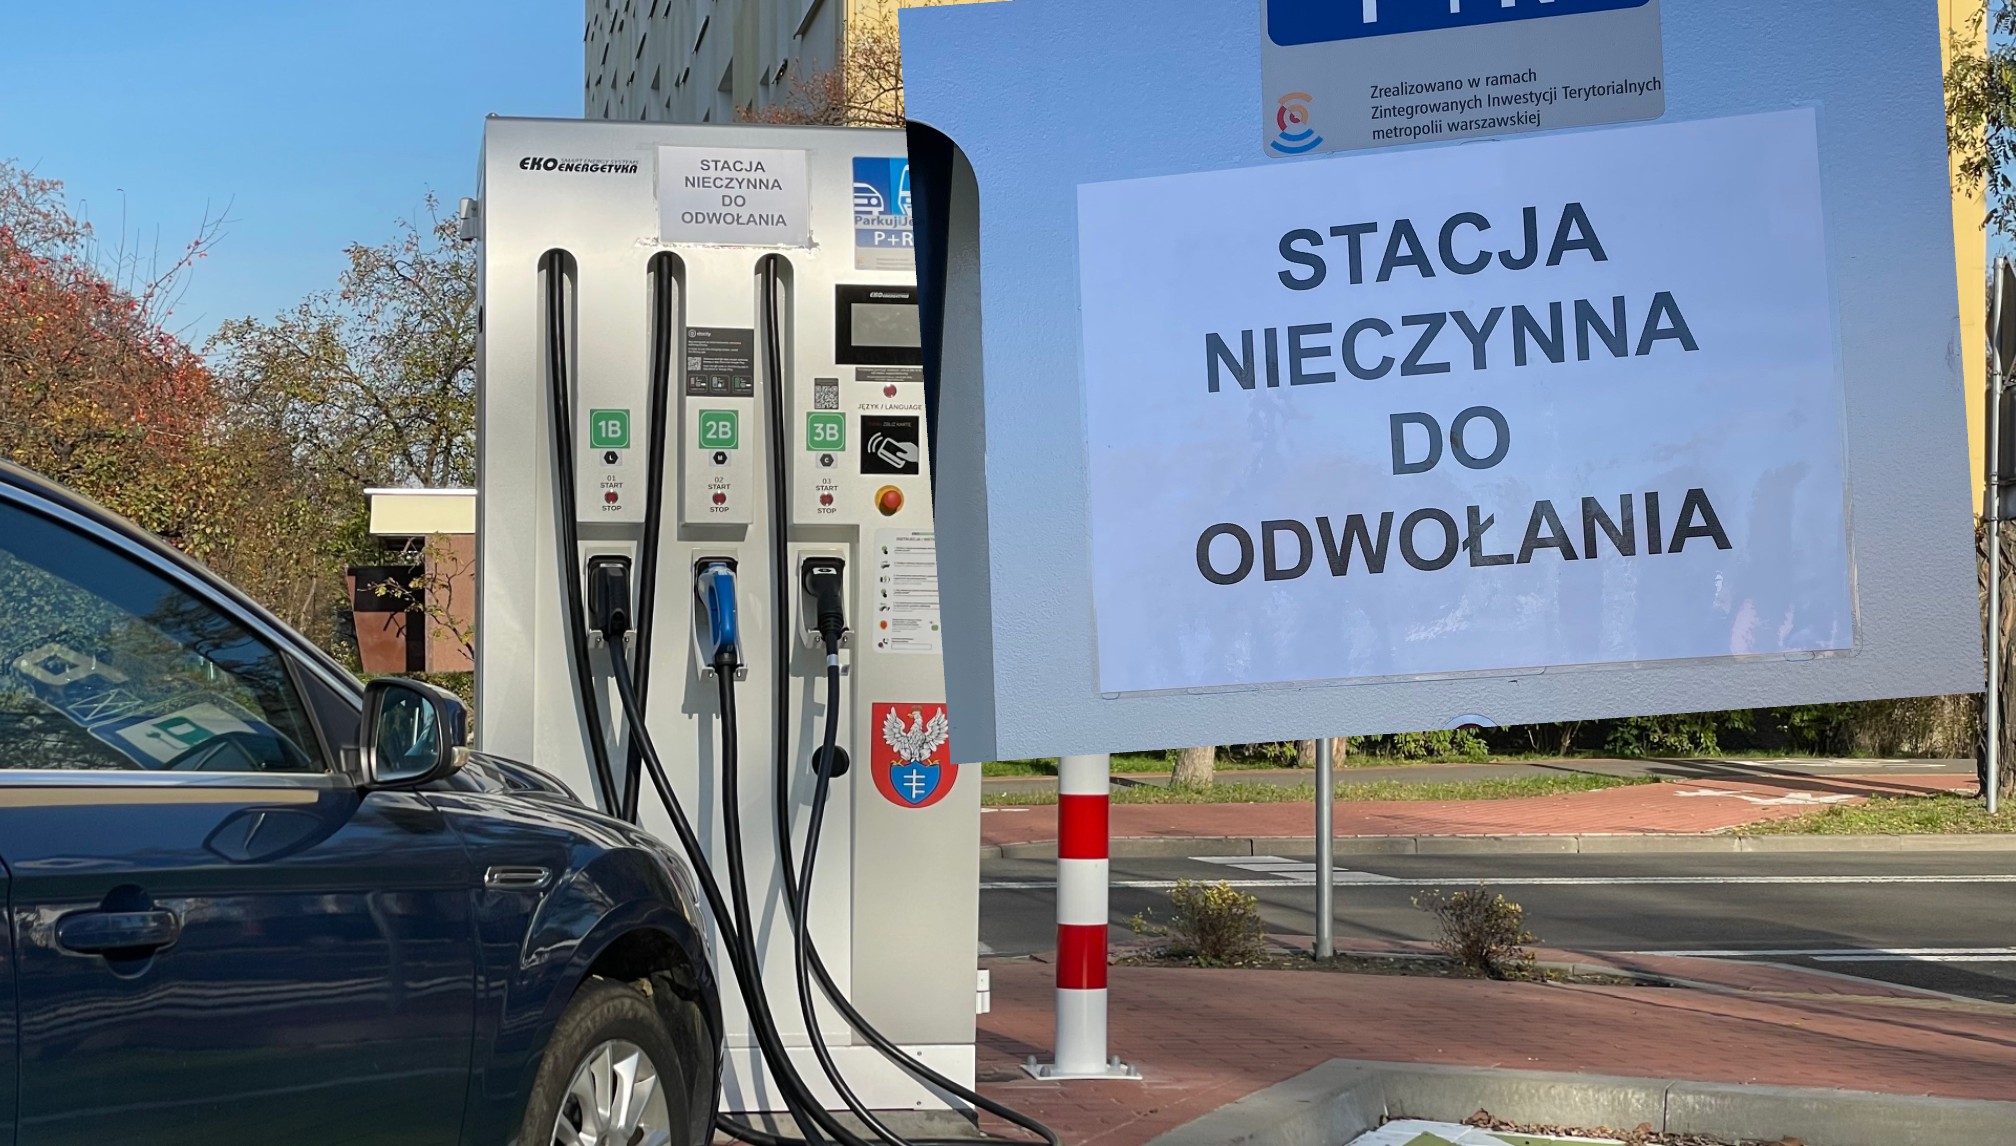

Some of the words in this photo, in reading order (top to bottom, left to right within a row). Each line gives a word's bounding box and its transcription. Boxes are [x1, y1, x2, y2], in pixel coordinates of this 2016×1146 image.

[1370, 79, 1463, 98] Zrealizowano
[1468, 77, 1480, 88] w
[1486, 68, 1537, 86] ramach
[1371, 95, 1482, 119] Zintegrowanych
[1487, 87, 1557, 106] Inwestycji
[1562, 76, 1662, 101] Terytorialnych
[1372, 120, 1442, 140] metropolii
[1447, 110, 1541, 132] warszawskiej
[519, 157, 558, 172] EKO
[558, 163, 638, 174] ENERGETYKA
[700, 159, 766, 172] STACJA
[684, 176, 782, 190] NIECZYNNA
[722, 194, 746, 207] DO
[681, 211, 788, 226] ODWOŁANIA
[874, 231, 914, 246] P+R
[1277, 202, 1609, 291] STACJA
[1205, 291, 1699, 393] NIECZYNNA
[598, 420, 622, 438] 1B
[706, 421, 732, 439] 2B
[813, 423, 839, 441] 3B
[1389, 405, 1511, 475] DO
[1196, 488, 1732, 585] ODWOŁANIA
